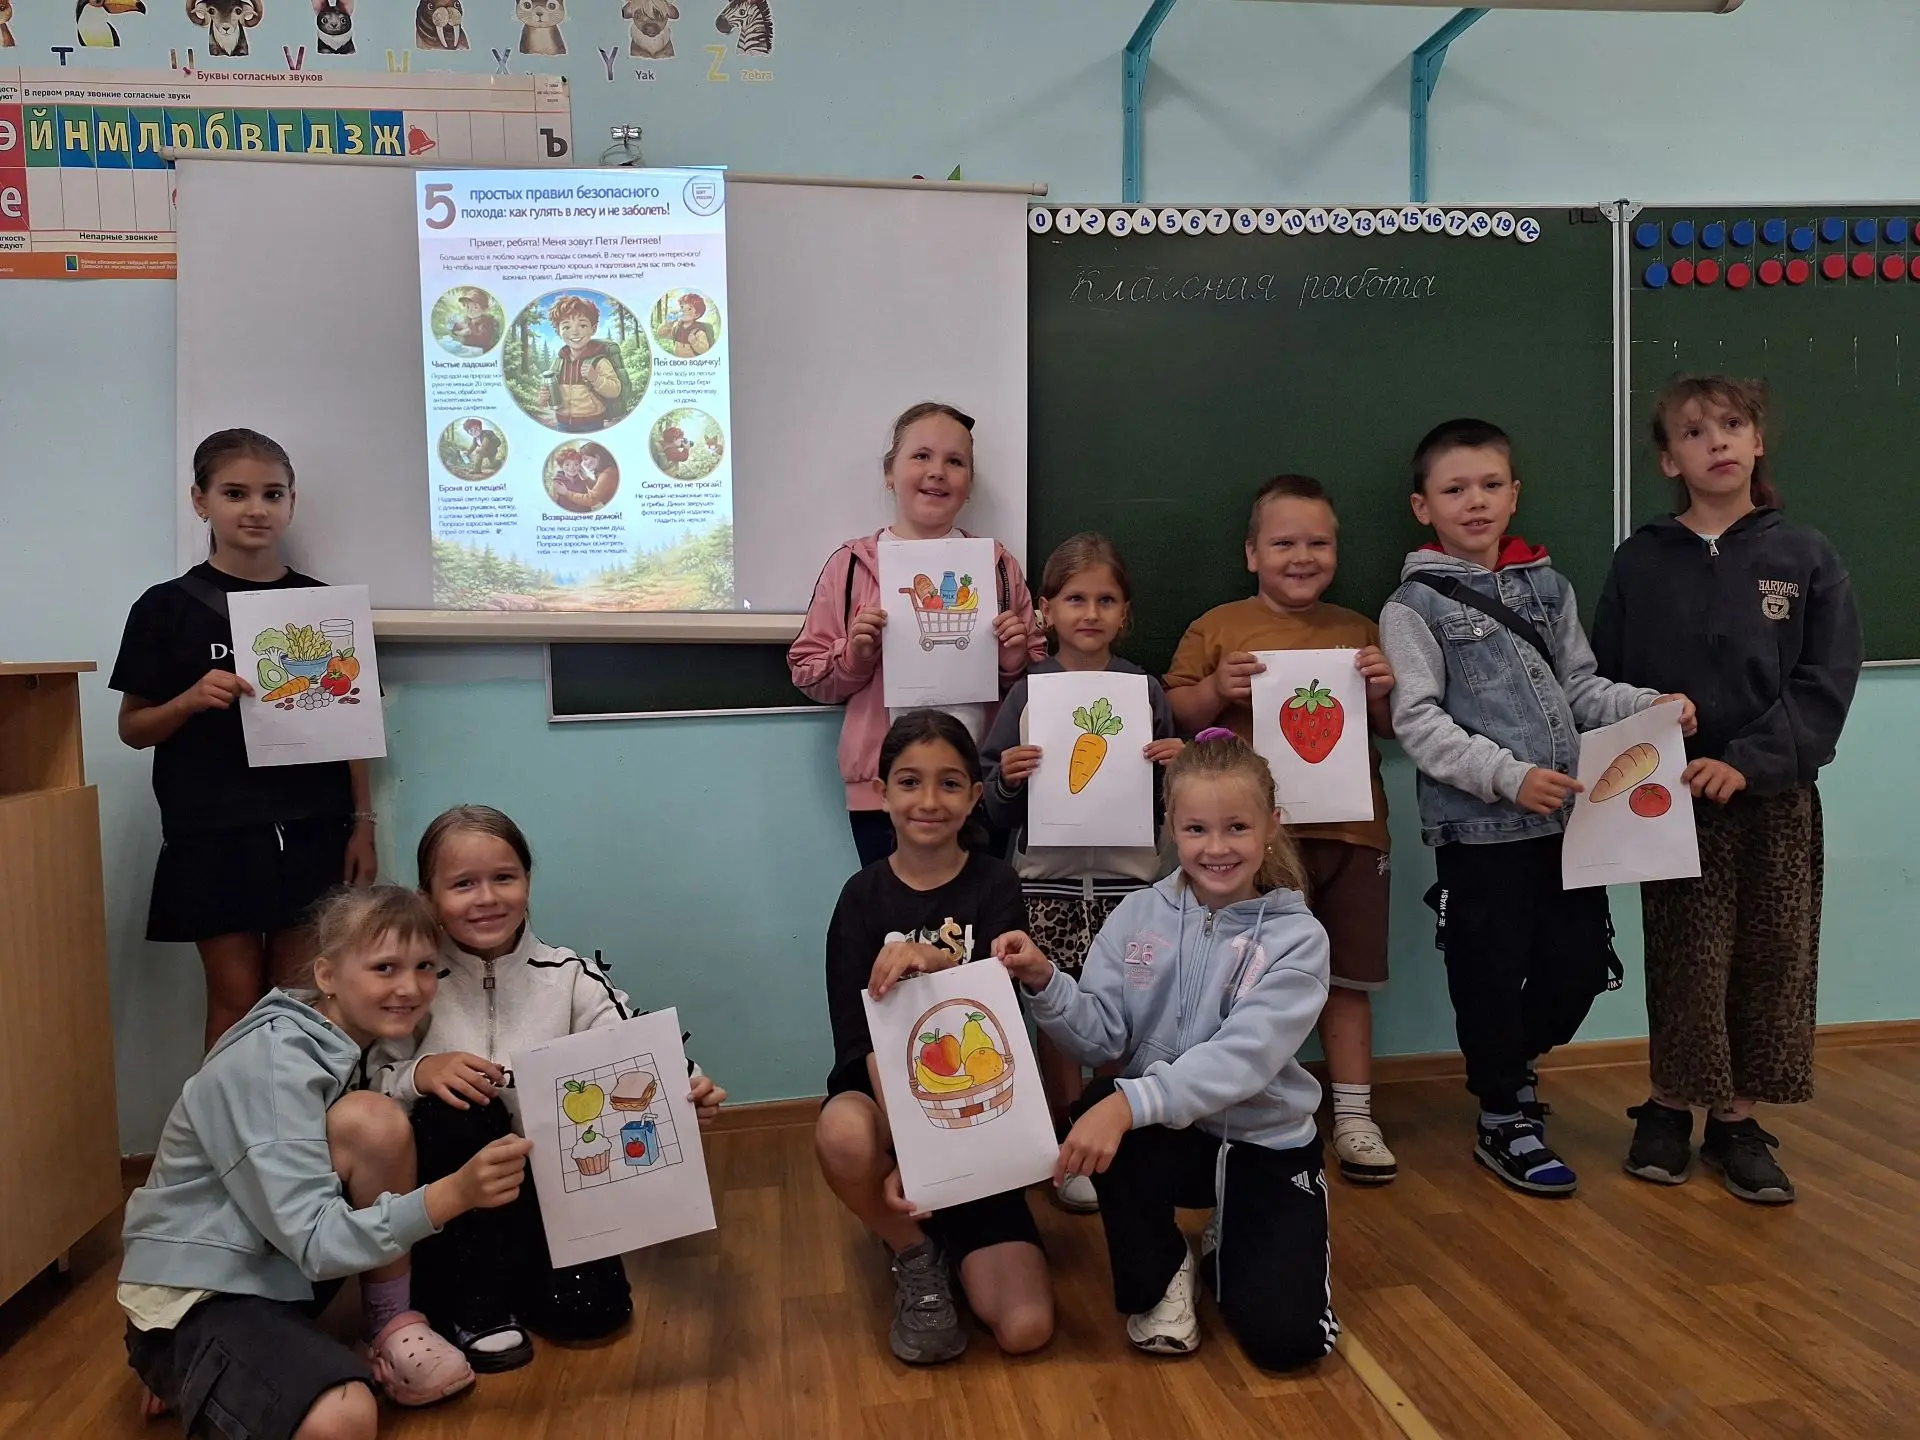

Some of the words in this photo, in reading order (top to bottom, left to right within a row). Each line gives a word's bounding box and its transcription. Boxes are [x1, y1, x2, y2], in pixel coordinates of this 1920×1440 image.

[599, 46, 618, 80] Y
[706, 46, 728, 81] Z
[197, 70, 230, 80] Буквы
[232, 72, 286, 81] согласных
[288, 73, 323, 82] звуков
[635, 70, 655, 80] Yak
[741, 70, 774, 80] Zebra
[168, 92, 190, 100] звуки
[205, 112, 230, 150] б
[470, 189, 522, 204] простых
[526, 188, 573, 202] правил
[577, 185, 659, 199] безопасного
[425, 183, 456, 230] 5
[461, 208, 506, 219] похода:
[509, 208, 527, 217] как
[530, 207, 563, 220] гулять
[566, 208, 571, 216] в
[573, 207, 596, 219] лесу
[599, 207, 605, 216] и
[608, 207, 619, 216] не
[622, 202, 670, 216] заболеть!
[1035, 213, 1046, 227] 0
[1064, 214, 1071, 227] 1
[1086, 214, 1098, 228] 2
[1116, 217, 1125, 231] 3
[1141, 215, 1150, 227] 4
[1166, 215, 1176, 228] 5
[1190, 216, 1200, 229] 6
[1213, 214, 1222, 227] 7
[1240, 214, 1251, 227] 8
[1265, 213, 1274, 226] 9
[1285, 214, 1302, 230] 10
[1309, 214, 1324, 227] 11
[1332, 213, 1348, 230] 12
[1355, 217, 1371, 231] 13
[1379, 215, 1396, 228] 14
[1402, 212, 1418, 225] 15
[1426, 213, 1442, 226] 16
[1449, 215, 1466, 230] 17
[1471, 216, 1488, 233] 18
[1496, 217, 1511, 231] 19
[1520, 220, 1539, 239] 20
[80, 232, 123, 241] Непарные
[469, 239, 505, 248] Привет,
[507, 238, 540, 248] ребята!
[543, 238, 566, 246] Меня
[568, 239, 593, 248] зовут
[596, 237, 618, 245] Петя
[620, 236, 661, 245] Лентяев!
[1298, 266, 1439, 309] работа
[461, 360, 498, 368] ладошки!
[654, 358, 667, 366] Пей
[689, 357, 720, 368] водичку!
[439, 485, 462, 493] Броня
[475, 483, 506, 492] клещей!
[642, 481, 672, 489] Смотри,
[695, 480, 722, 489] трогай!
[542, 513, 593, 522] Возвращение
[595, 512, 622, 520] домой!
[1758, 580, 1799, 595] HARVARD
[1440, 888, 1449, 910] WASH
